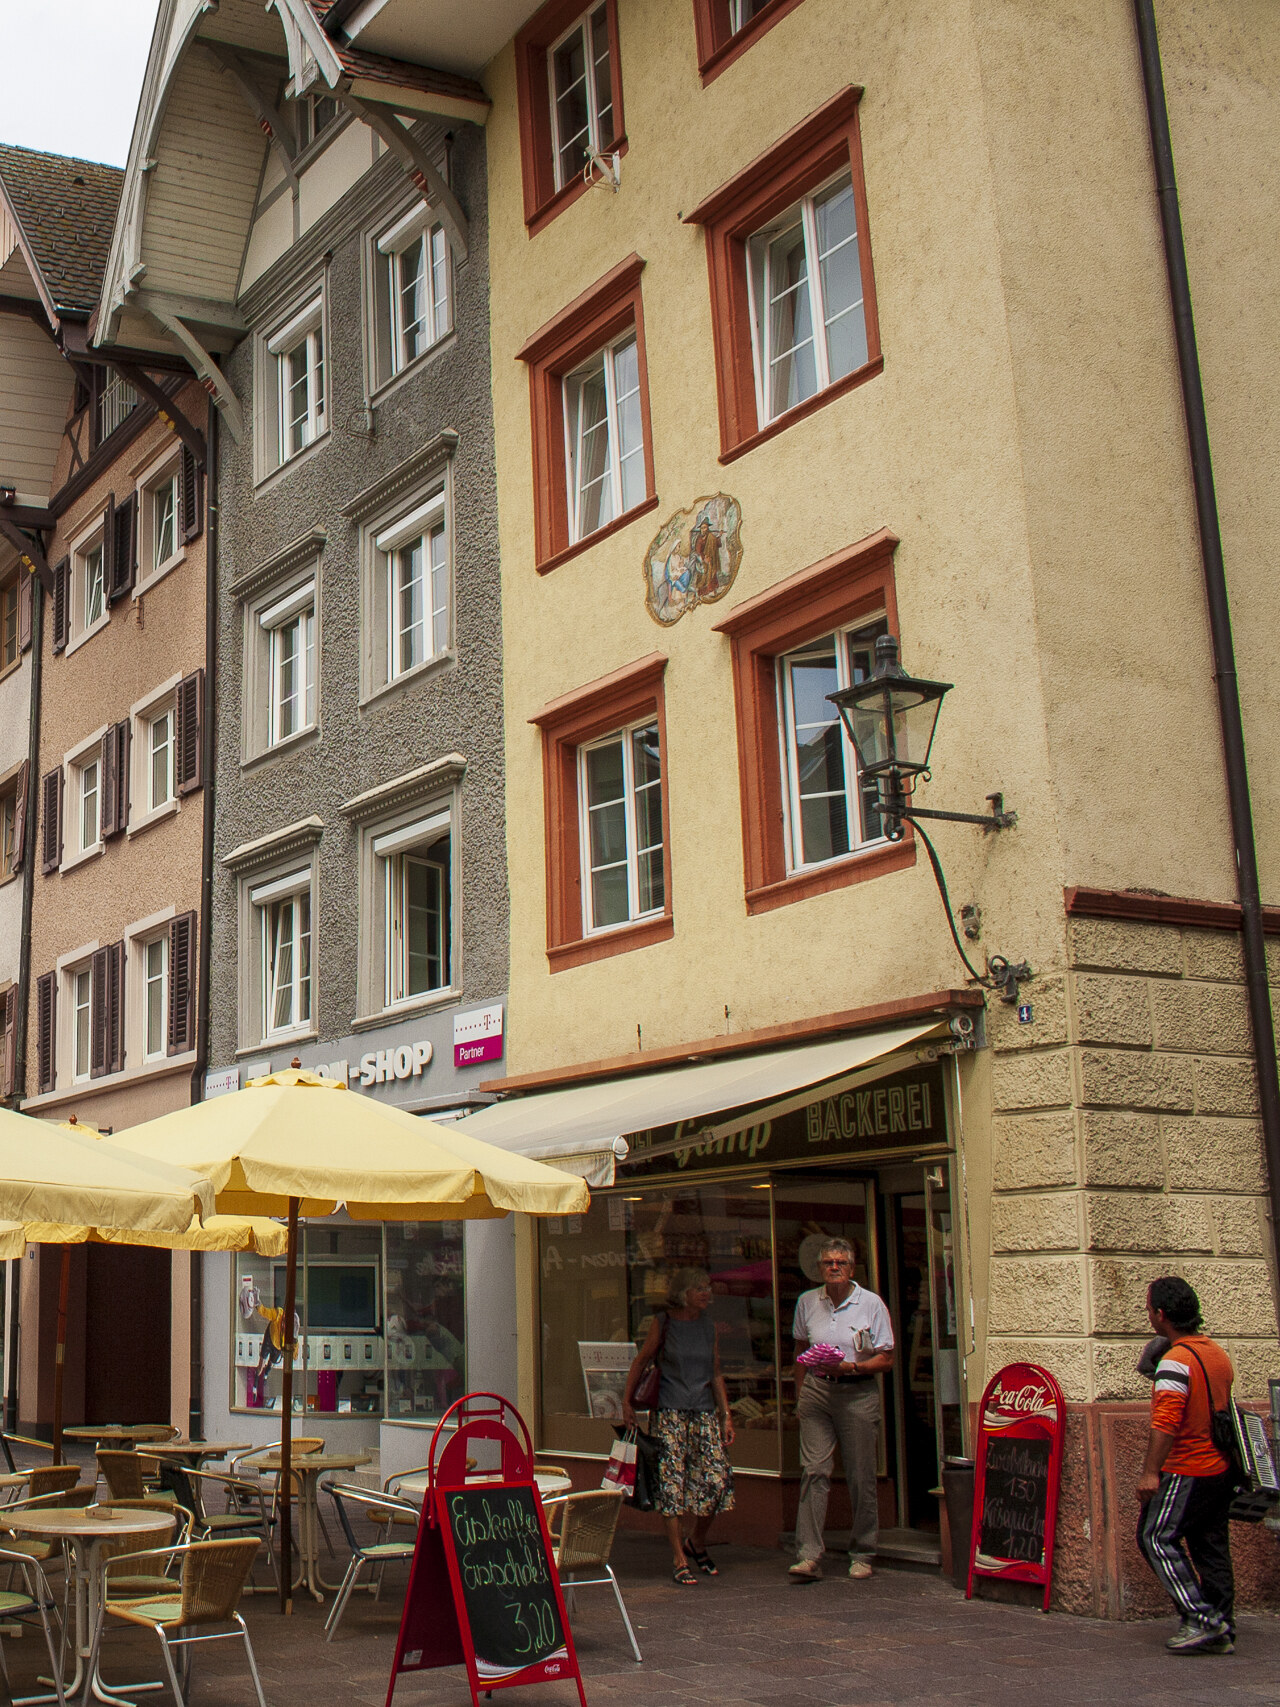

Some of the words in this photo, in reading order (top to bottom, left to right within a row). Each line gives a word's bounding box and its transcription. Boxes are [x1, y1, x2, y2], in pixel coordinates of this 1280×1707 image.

[1021, 1007, 1029, 1020] 4
[459, 1046, 484, 1061] Partner
[807, 1083, 932, 1142] BÄCKEREI
[1000, 1385, 1047, 1411] ca-Cola
